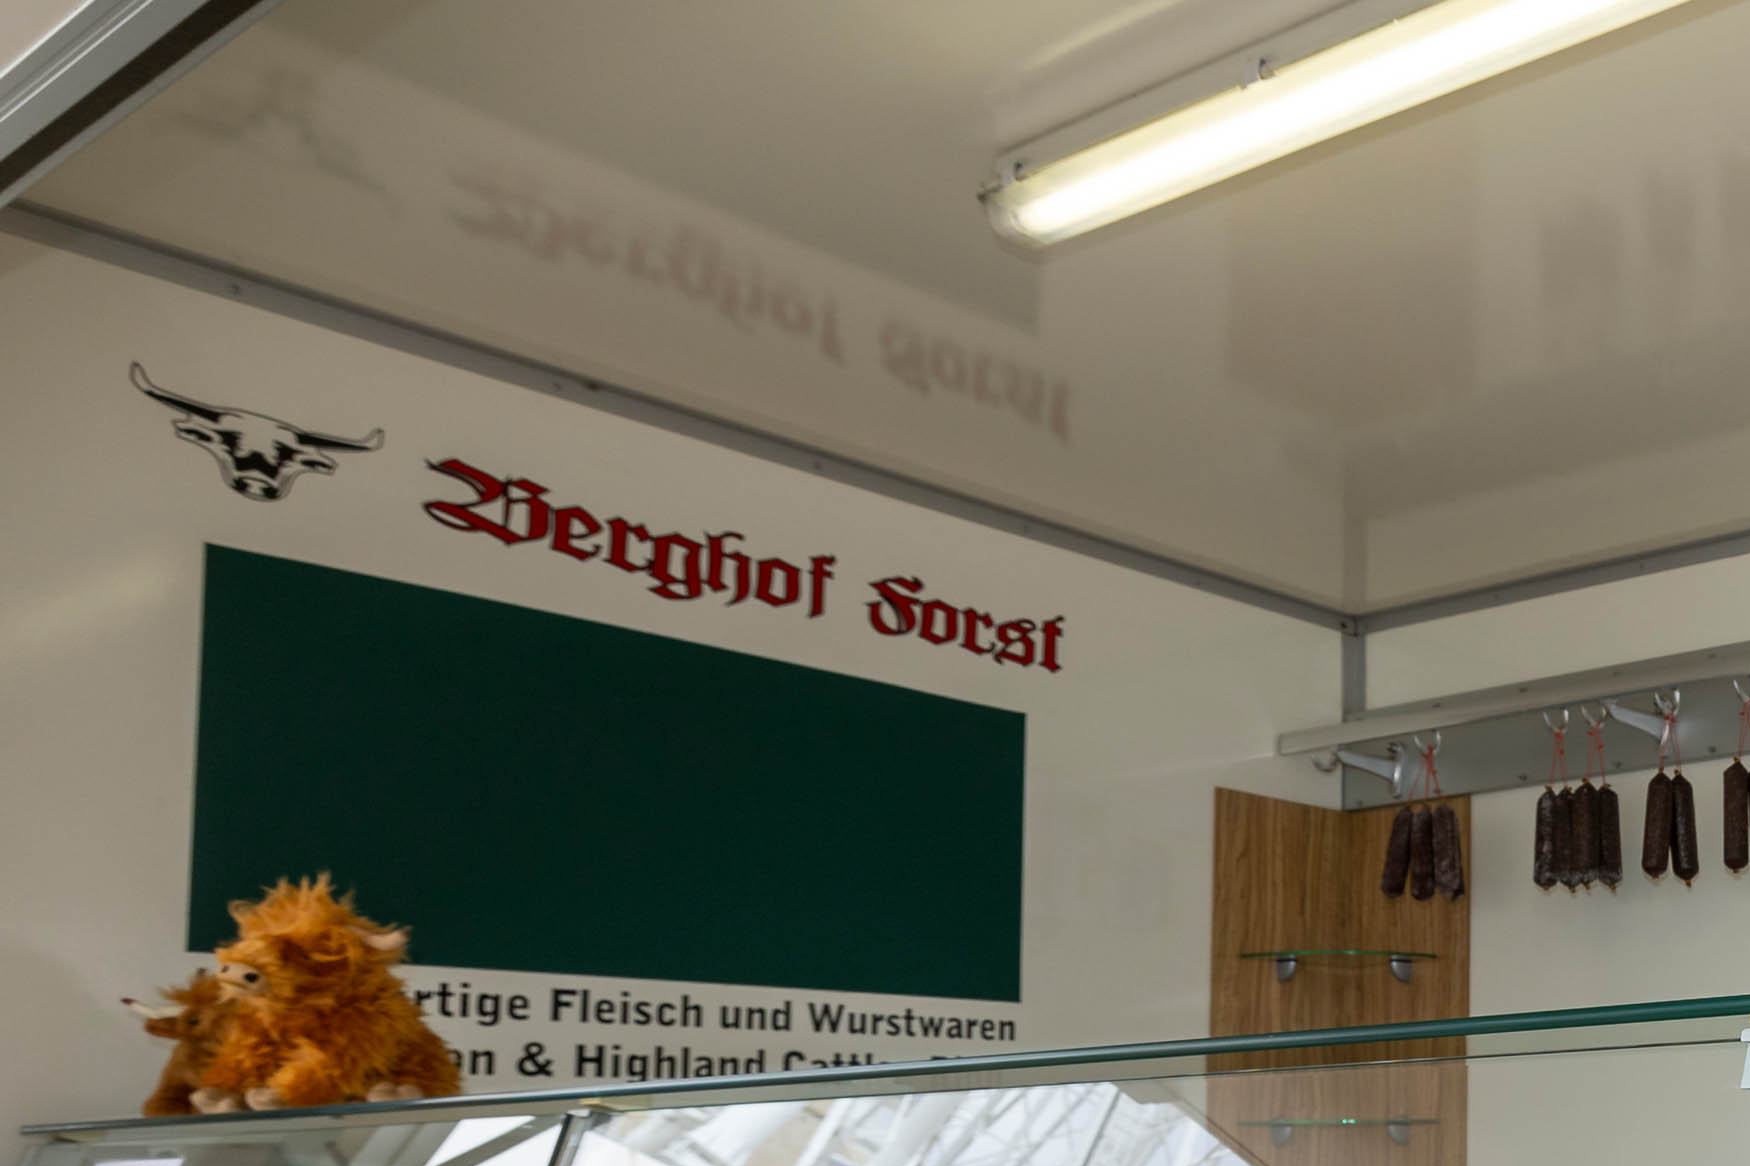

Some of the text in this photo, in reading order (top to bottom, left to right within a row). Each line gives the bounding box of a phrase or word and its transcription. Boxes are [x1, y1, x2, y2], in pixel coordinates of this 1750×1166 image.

[422, 457, 1065, 673] Berghof Forst
[414, 982, 1017, 1042] rtige Fleisch und Wurstwaren
[517, 1041, 553, 1077] &
[575, 1044, 767, 1083] Highland
